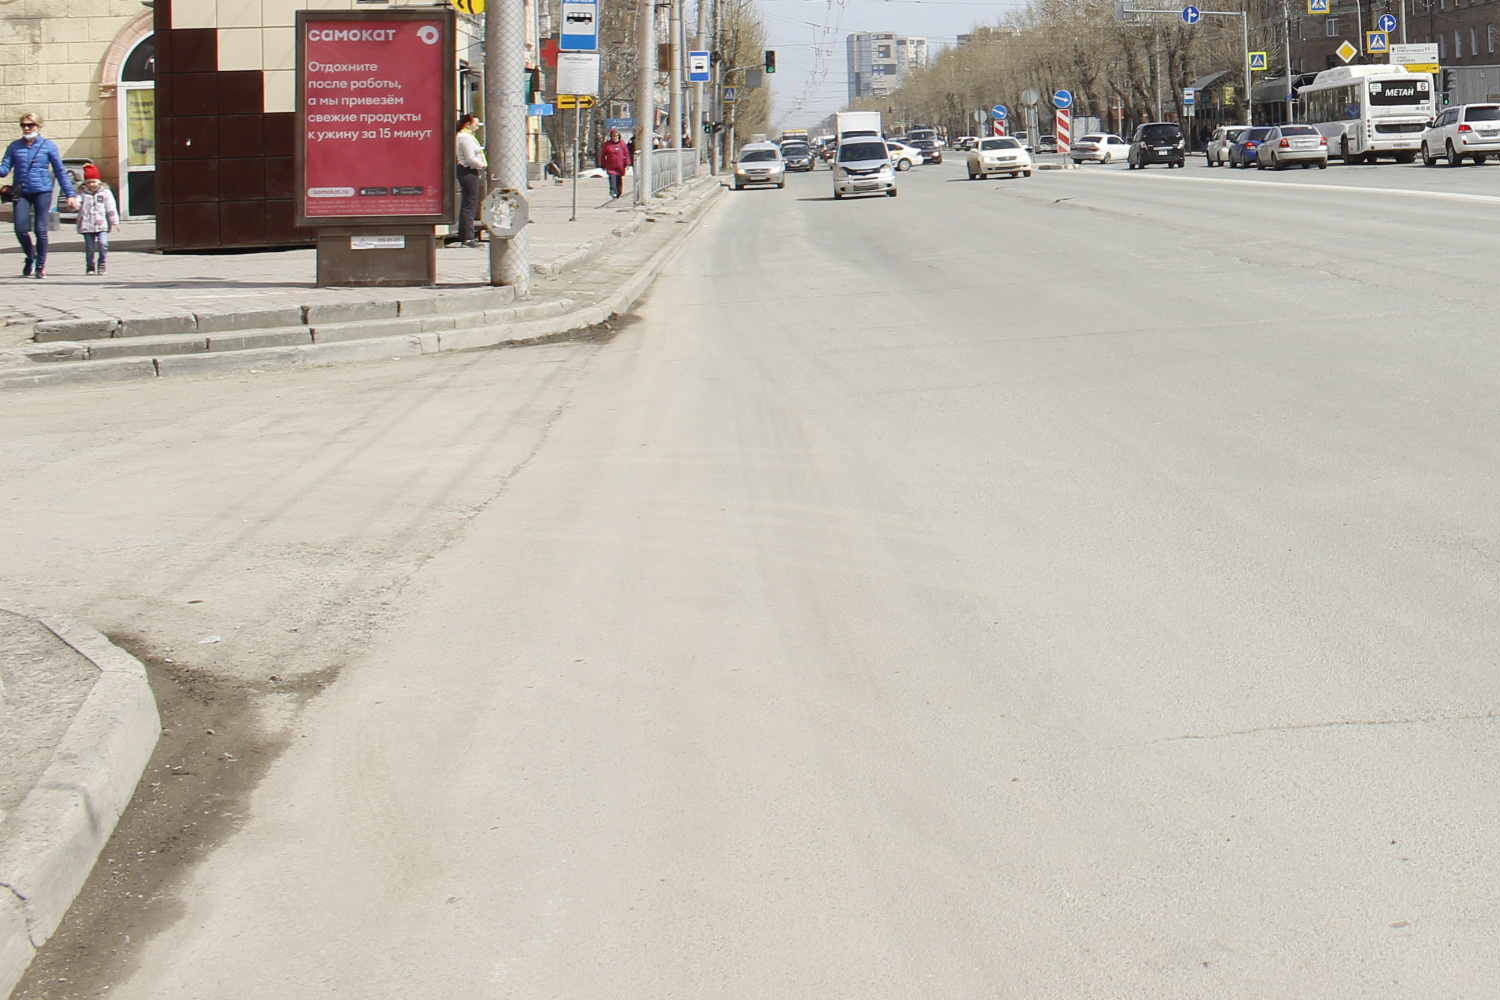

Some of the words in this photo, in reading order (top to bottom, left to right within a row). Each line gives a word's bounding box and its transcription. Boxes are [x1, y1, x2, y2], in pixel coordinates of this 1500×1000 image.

[308, 29, 396, 42] самокат
[308, 61, 378, 73] Отдохните
[308, 80, 348, 89] после
[350, 78, 402, 91] работы,
[1420, 83, 1426, 91] 6
[1385, 88, 1415, 97] МЕТАН
[308, 97, 316, 105] а
[320, 97, 338, 105] мы
[341, 95, 404, 107] привезём
[308, 113, 357, 122] свежие
[360, 113, 421, 124] продукты
[308, 130, 315, 139] к
[317, 130, 359, 141] ужину
[361, 130, 376, 139] за
[379, 128, 391, 139] 15
[394, 129, 432, 140] минут
